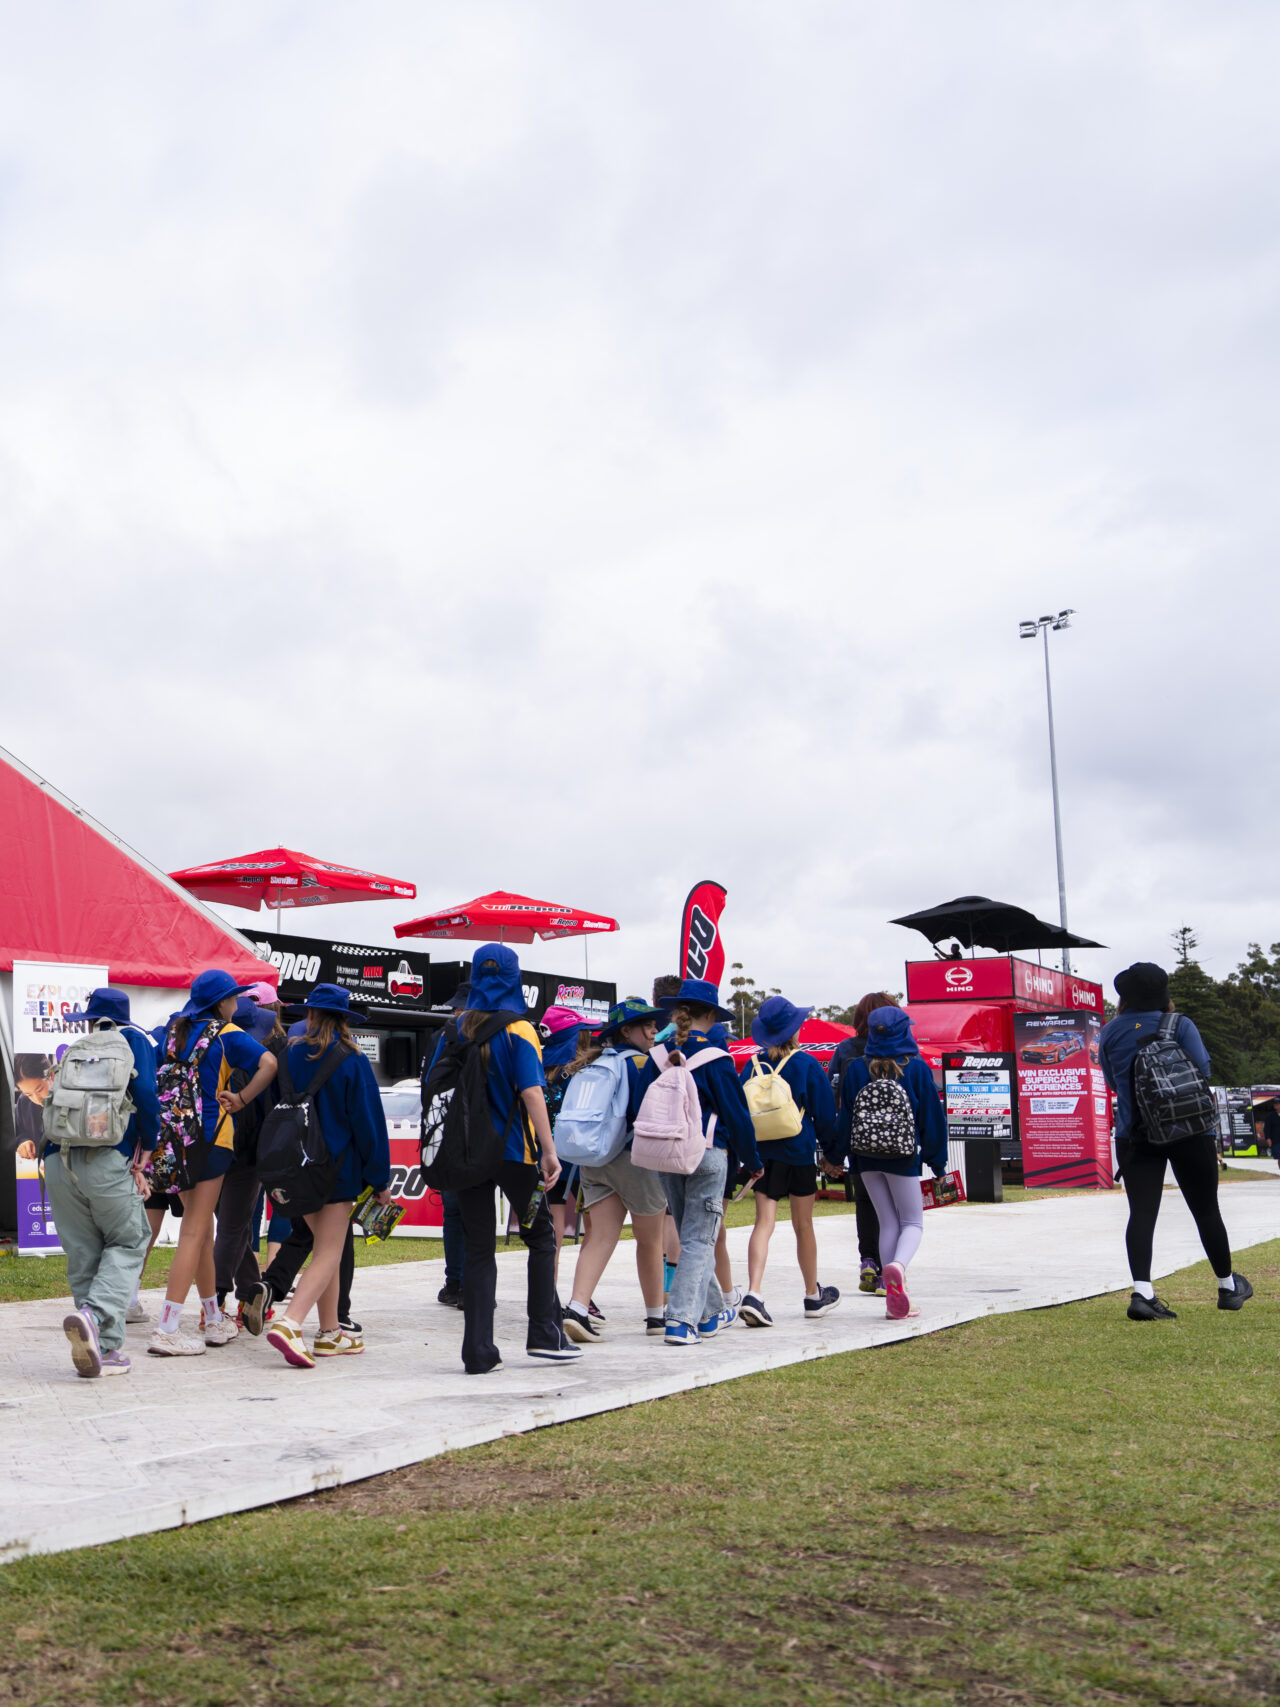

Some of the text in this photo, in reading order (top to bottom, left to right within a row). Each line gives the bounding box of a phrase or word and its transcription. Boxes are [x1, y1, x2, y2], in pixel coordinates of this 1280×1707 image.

[556, 918, 578, 927] Repco
[363, 966, 384, 978] MINI
[1033, 976, 1053, 995] HINO
[557, 984, 584, 1001] RETRO
[1079, 991, 1096, 1007] HINO
[1026, 1019, 1075, 1027] REWARDS
[962, 1056, 1003, 1069] Repco
[1018, 1068, 1087, 1077] WIN EXCLUSIVE
[1025, 1075, 1078, 1084] SUPERCARS
